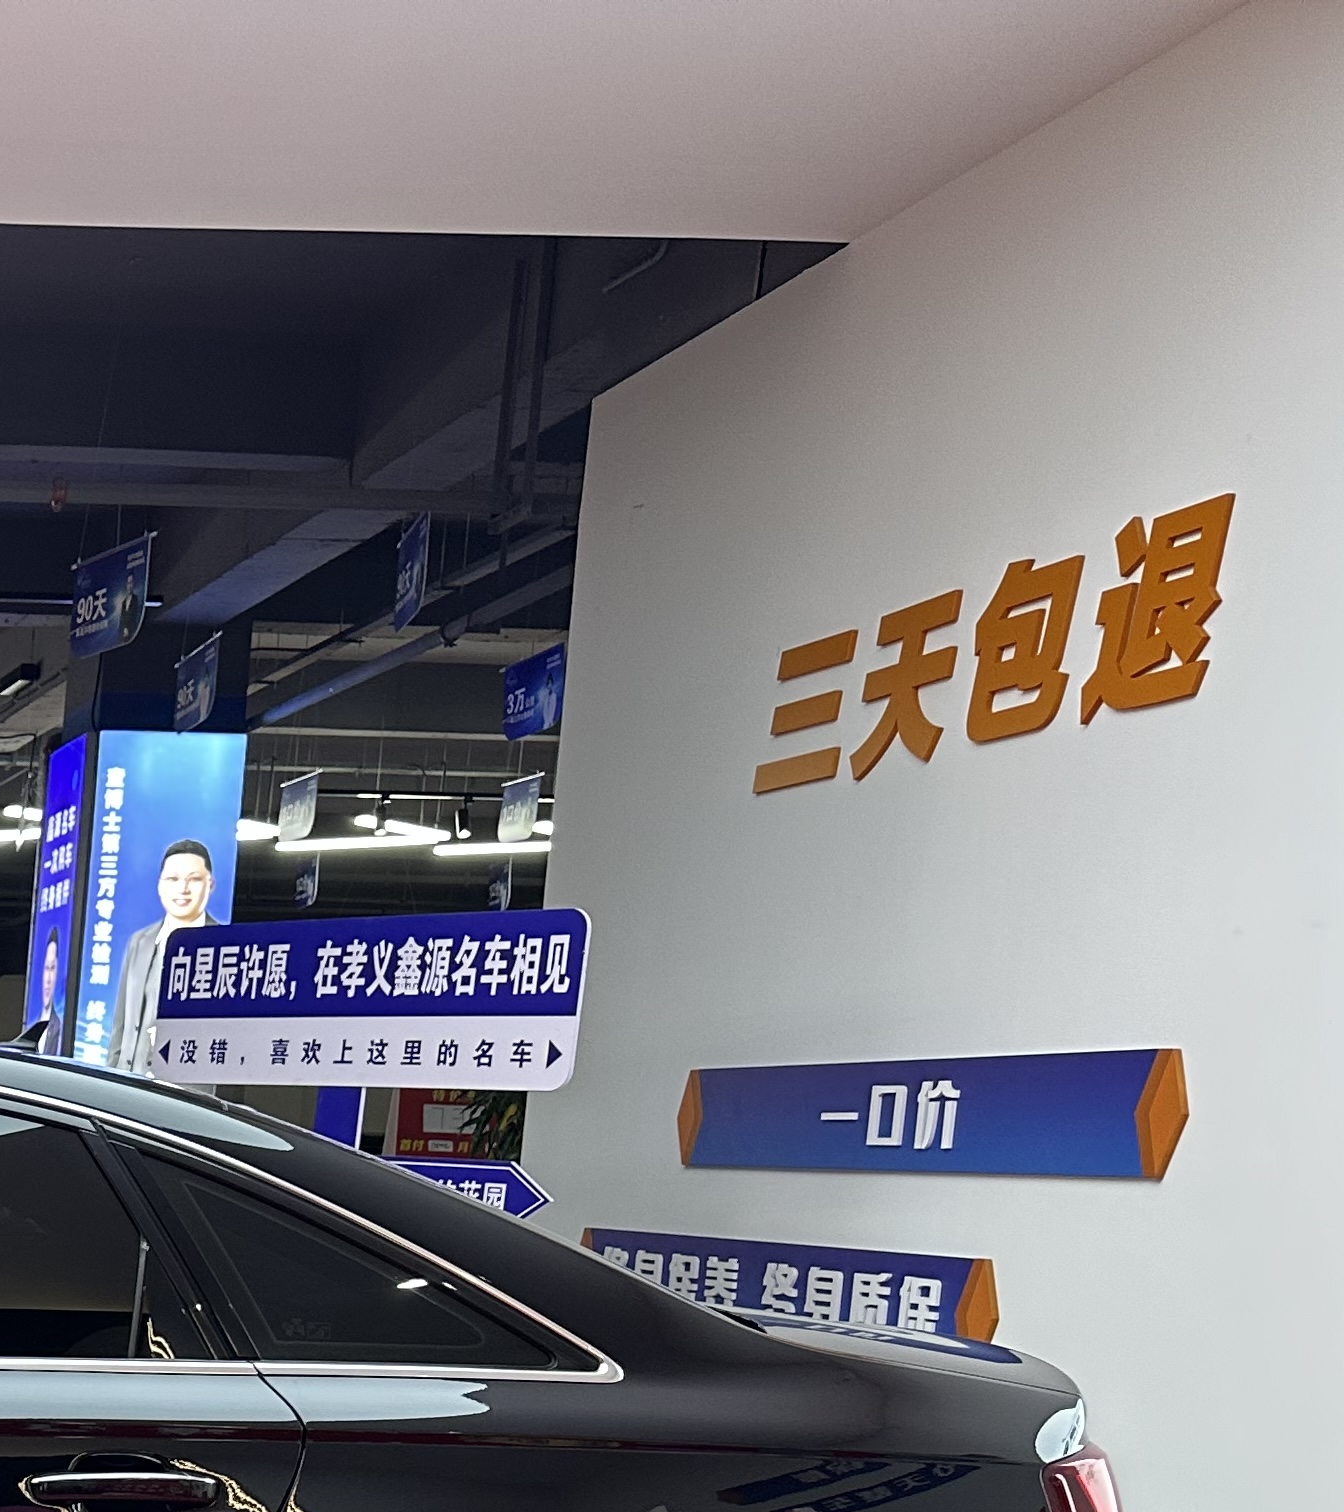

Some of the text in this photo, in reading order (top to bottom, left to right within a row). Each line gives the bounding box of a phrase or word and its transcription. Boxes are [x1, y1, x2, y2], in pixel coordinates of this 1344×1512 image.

[76, 588, 107, 624] 90天
[752, 493, 1236, 794] 三天包退
[820, 1080, 962, 1151] 一口价
